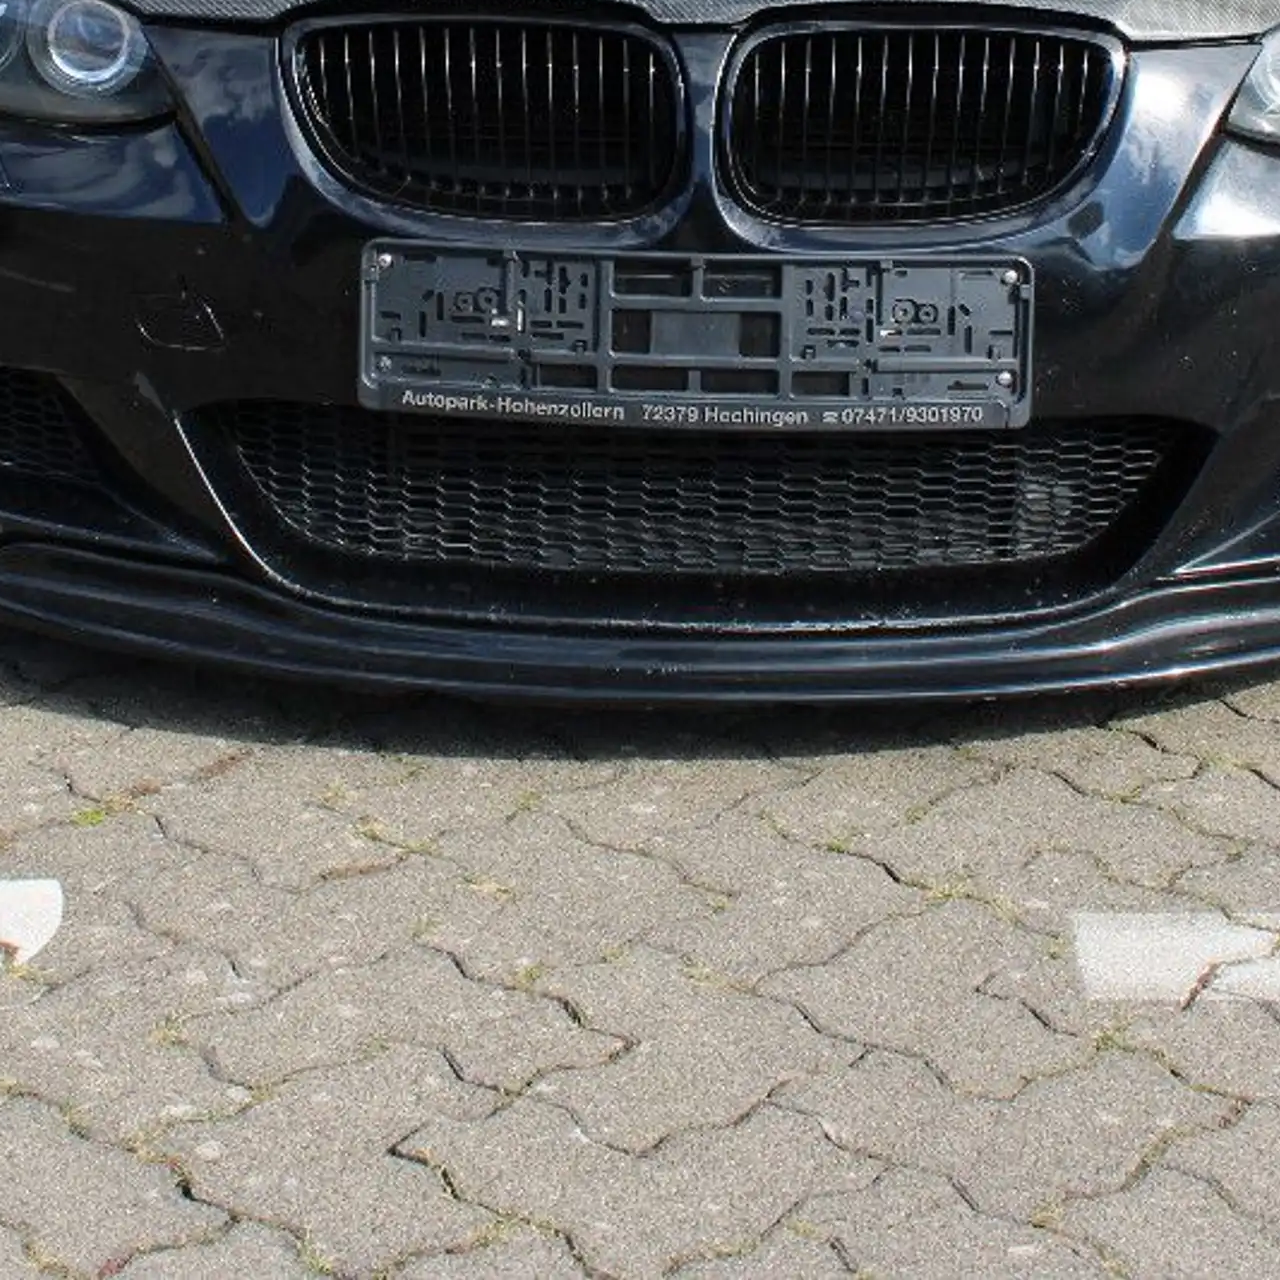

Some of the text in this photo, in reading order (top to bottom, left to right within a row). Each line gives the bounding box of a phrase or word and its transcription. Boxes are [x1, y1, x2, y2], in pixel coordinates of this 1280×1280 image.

[401, 389, 625, 420] Autopark-Hohenzollern
[641, 403, 699, 424] 72379
[841, 406, 984, 425] 07471/9301970
